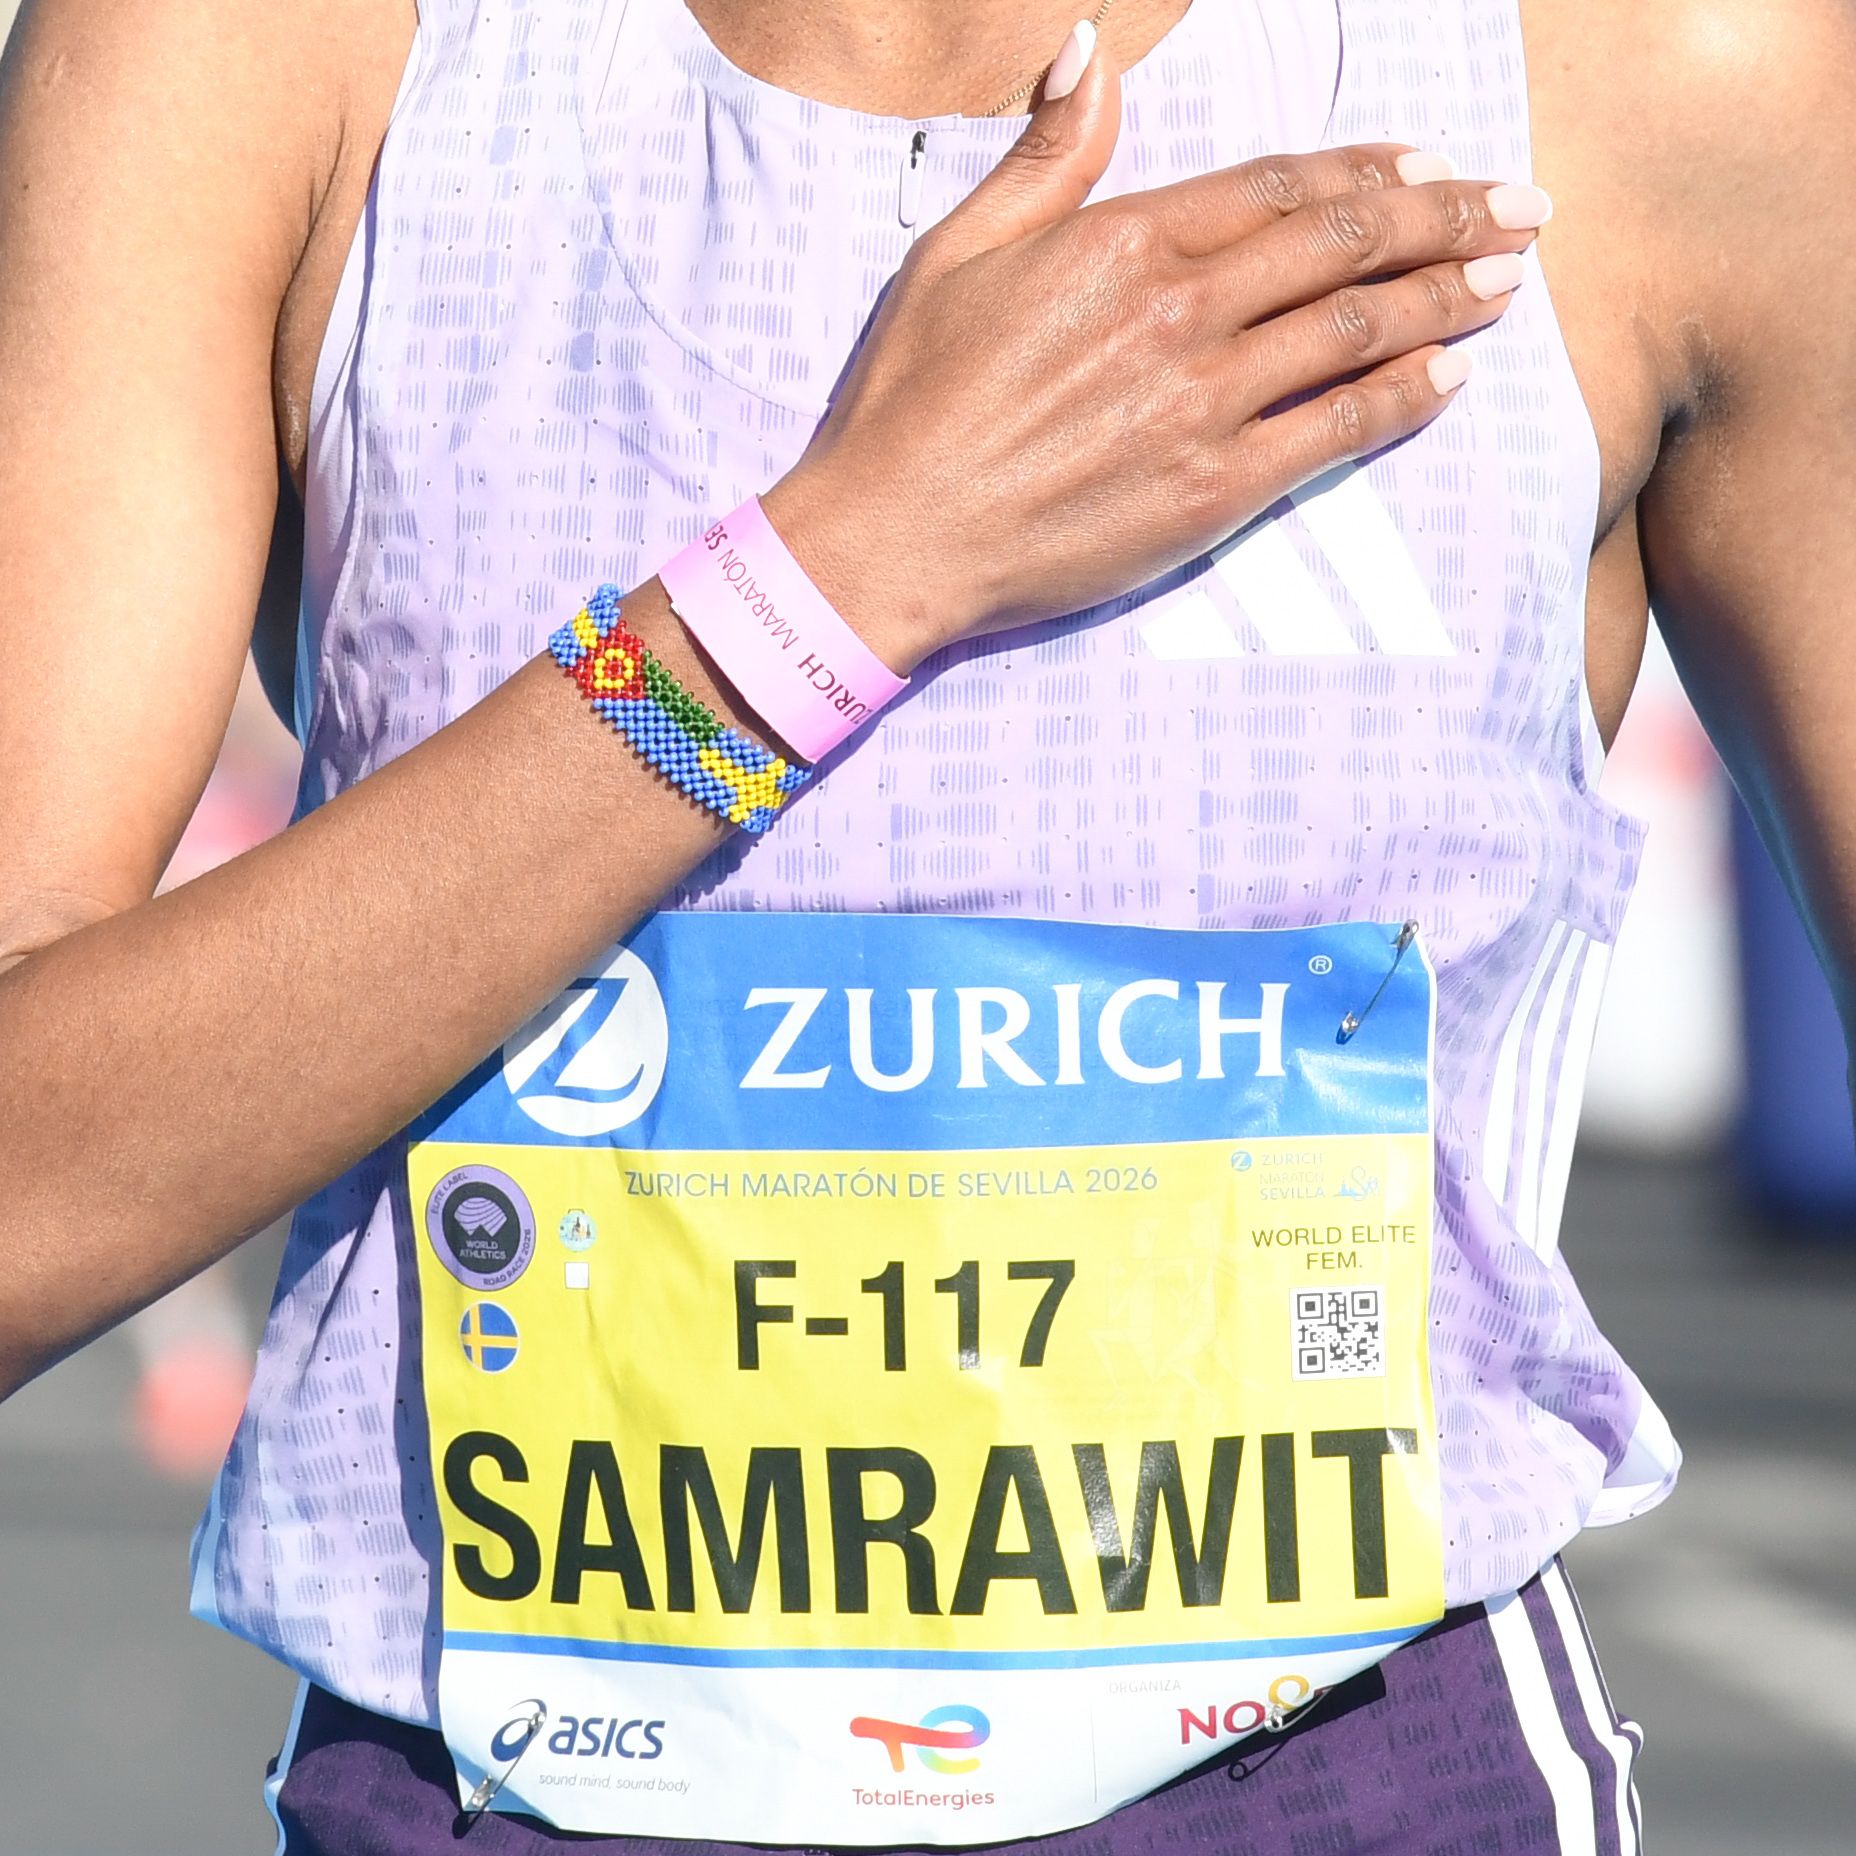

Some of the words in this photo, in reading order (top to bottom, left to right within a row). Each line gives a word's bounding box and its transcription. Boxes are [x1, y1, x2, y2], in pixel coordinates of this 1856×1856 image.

[716, 547, 799, 650] MARATÓN
[797, 652, 874, 725] ZURICH
[739, 978, 1290, 1092] ZURICH
[1260, 1151, 1323, 1166] ZURICH
[443, 1171, 469, 1192] LABEL
[624, 1170, 729, 1198] ZURICH
[742, 1166, 896, 1198] MARATÓN
[908, 1173, 945, 1198] DE
[957, 1169, 1075, 1197] SEVILLA
[1085, 1166, 1159, 1193] 2026
[1259, 1186, 1326, 1201] SEVILLA
[465, 1239, 498, 1250] WORLD
[1251, 1226, 1342, 1248] WORLD
[1351, 1224, 1416, 1244] ELITE
[459, 1247, 507, 1261] ATHLETICS
[1306, 1251, 1363, 1270] FEM.
[482, 1274, 508, 1286] ROAD
[506, 1255, 526, 1280] RACE
[733, 1258, 1076, 1372] F-117
[443, 1427, 1419, 1617] SAMRAWIT
[1108, 1678, 1182, 1694] ORGANIZA
[538, 1773, 578, 1787] sound
[578, 1774, 612, 1790] mind,
[616, 1776, 657, 1791] sound
[657, 1778, 692, 1795] body
[851, 1788, 995, 1811] TotalEnergies
